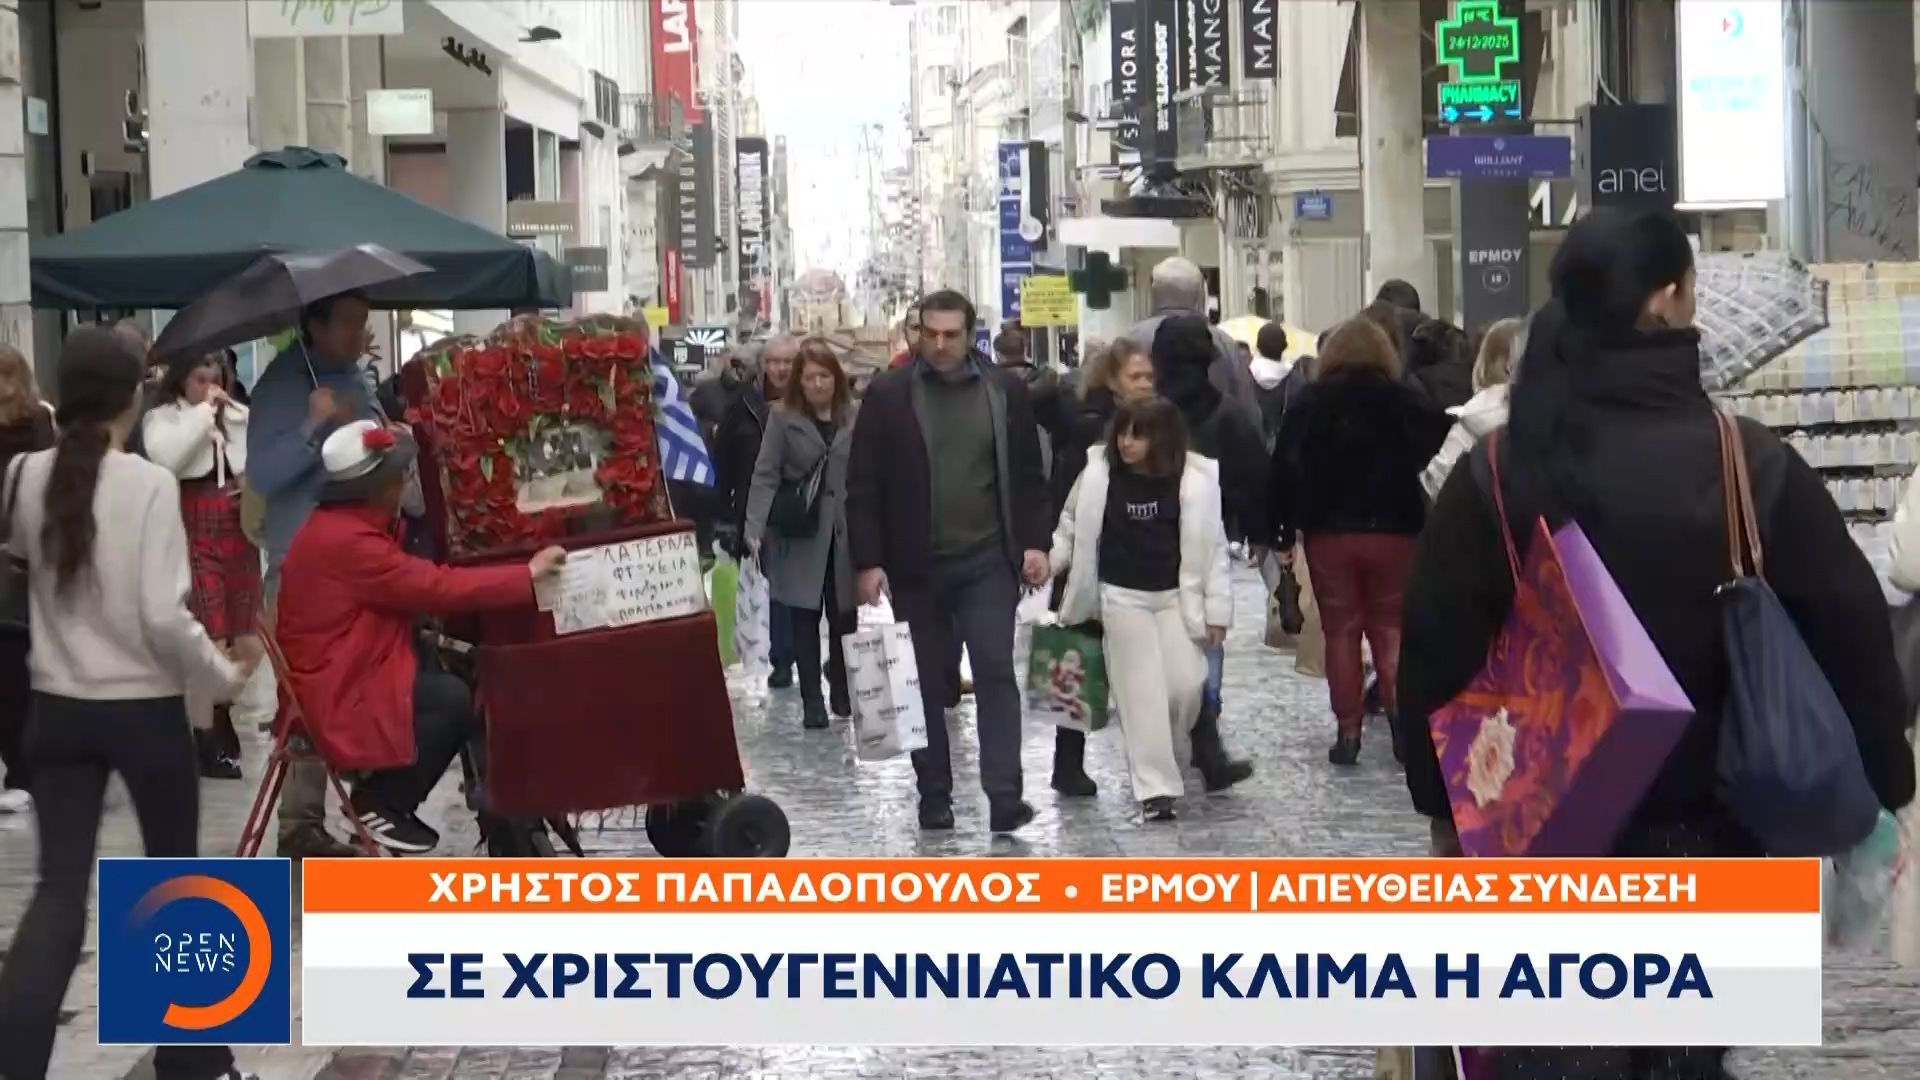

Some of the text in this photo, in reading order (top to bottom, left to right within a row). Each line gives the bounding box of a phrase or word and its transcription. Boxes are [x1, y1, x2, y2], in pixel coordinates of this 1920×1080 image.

[1120, 29, 1139, 139] SEHORA
[1442, 83, 1517, 104] PHARMACY
[1598, 160, 1667, 193] anel
